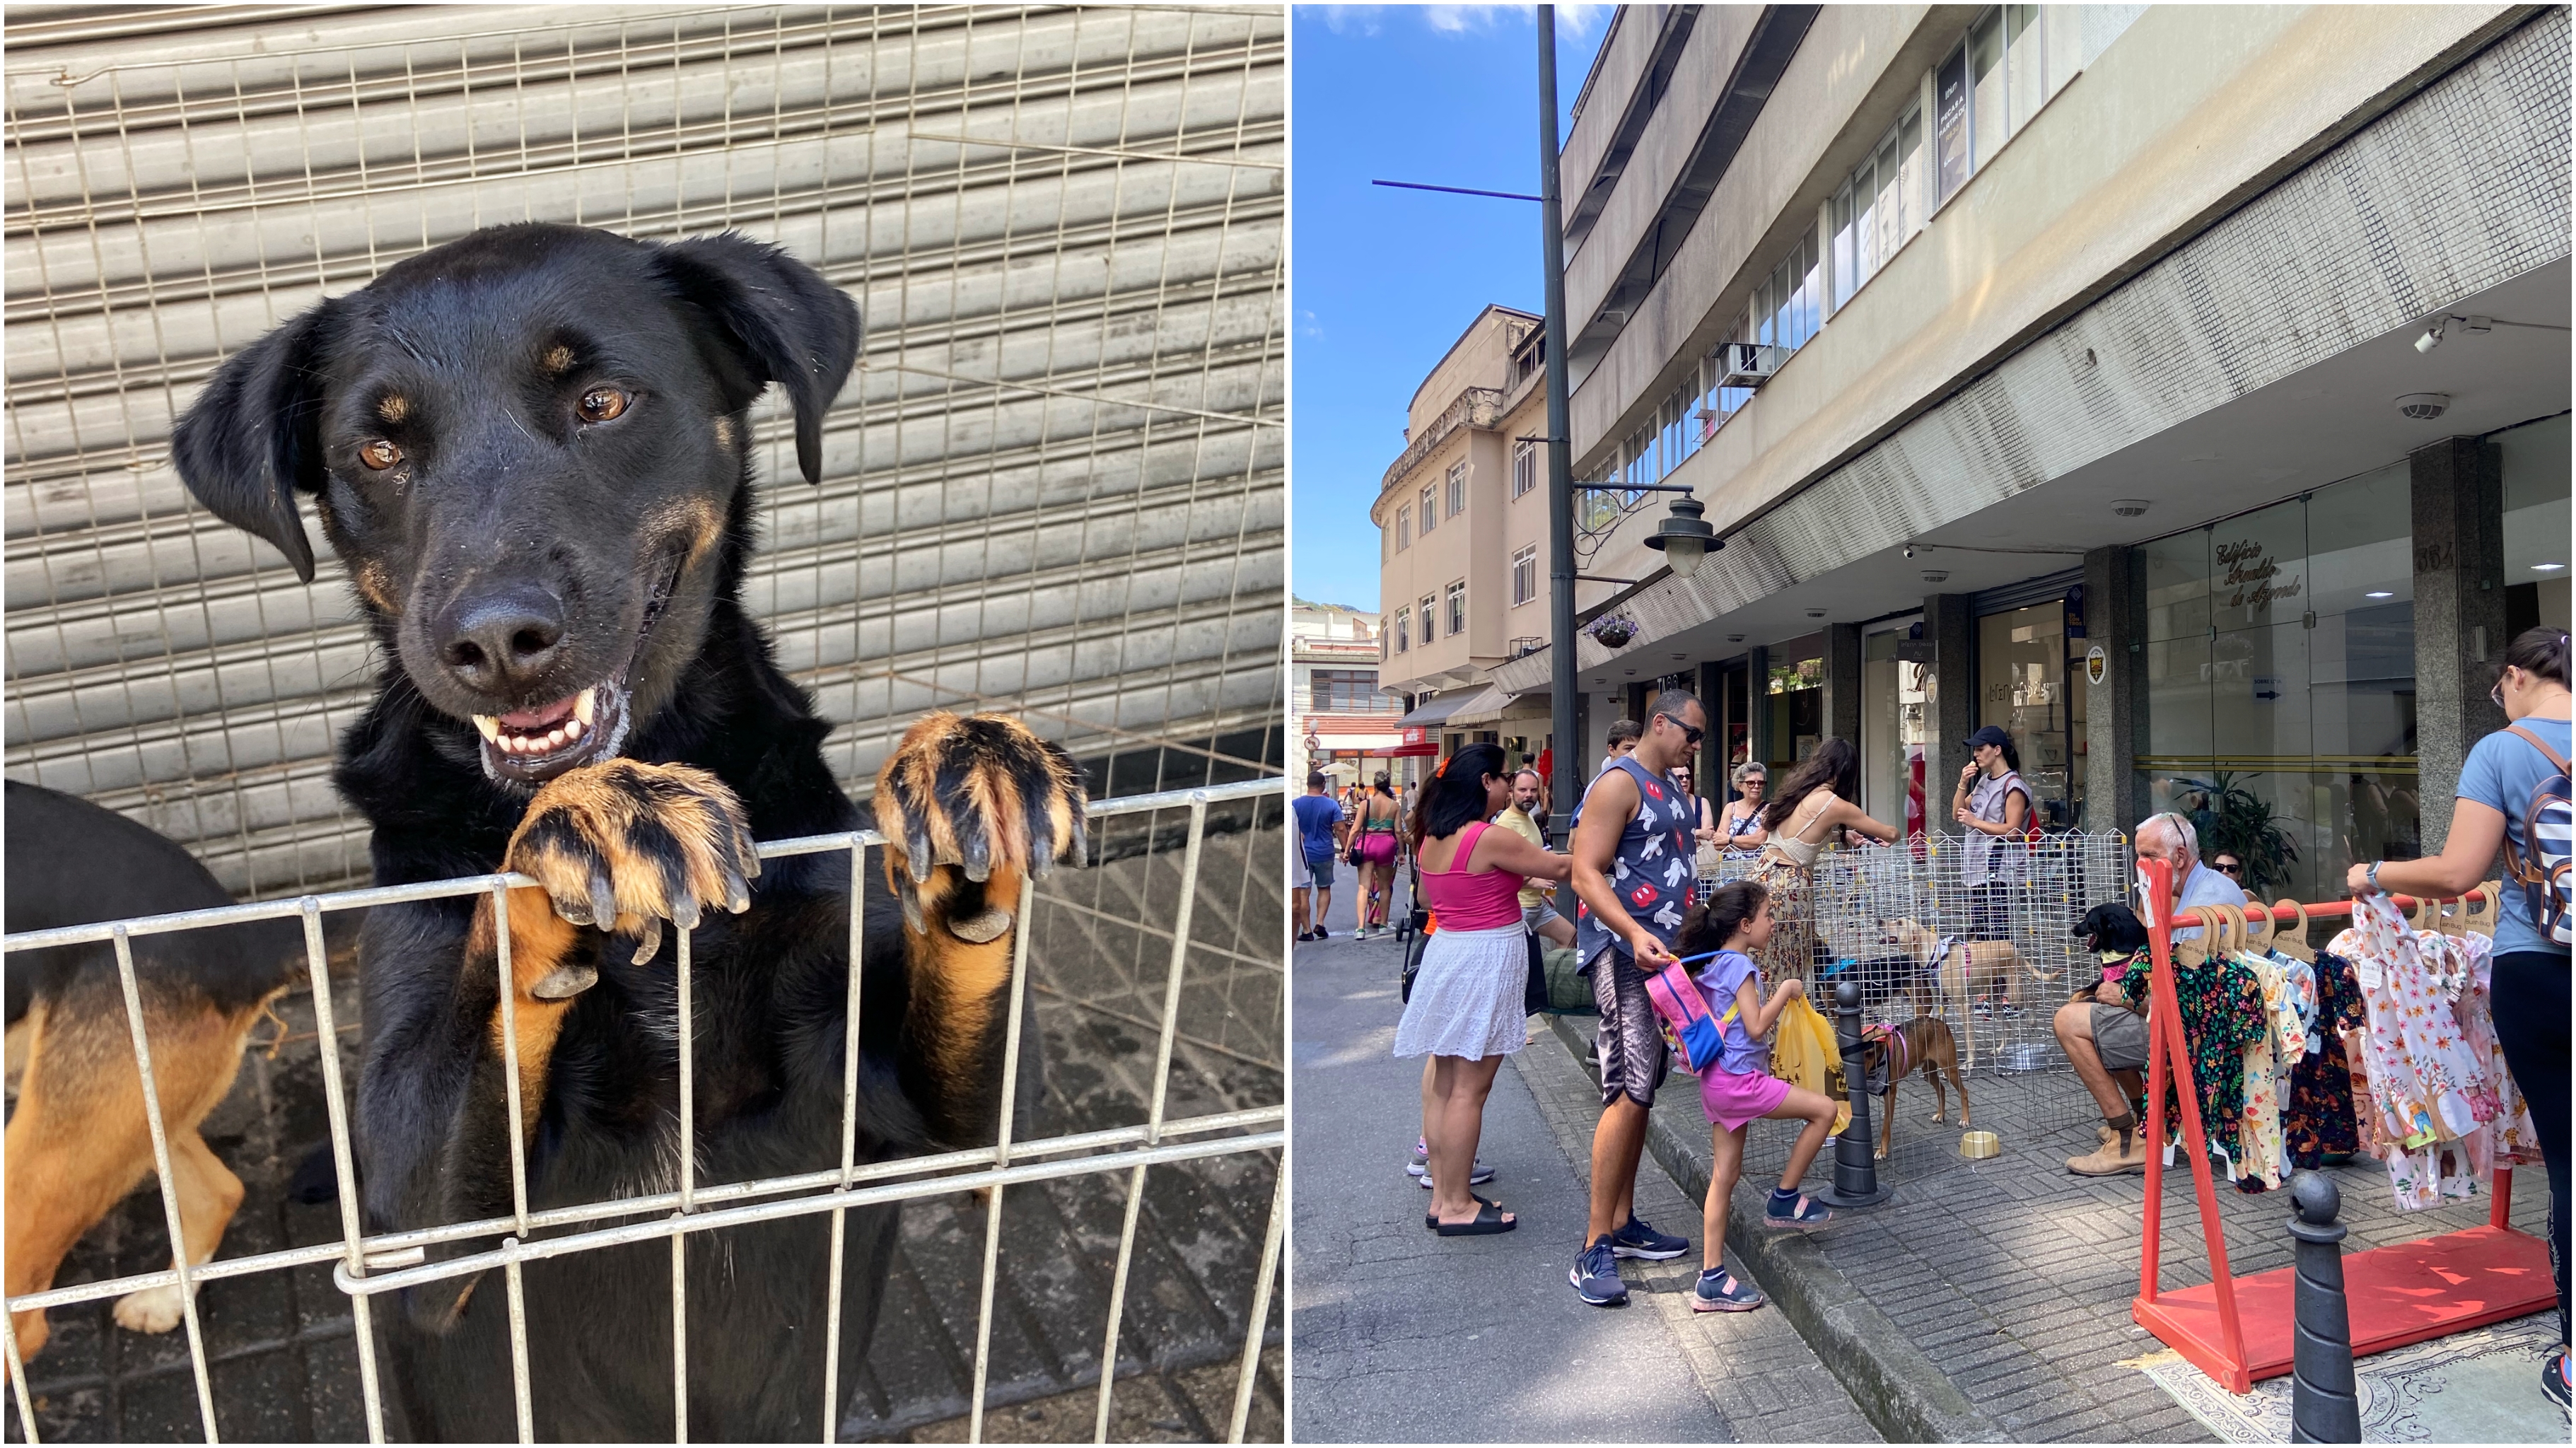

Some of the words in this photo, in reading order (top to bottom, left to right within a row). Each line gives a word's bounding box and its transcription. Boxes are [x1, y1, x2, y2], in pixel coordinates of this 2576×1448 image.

[1939, 113, 1958, 139] PARTIR
[2181, 943, 2195, 952] Bush
[2194, 947, 2205, 957] Bug
